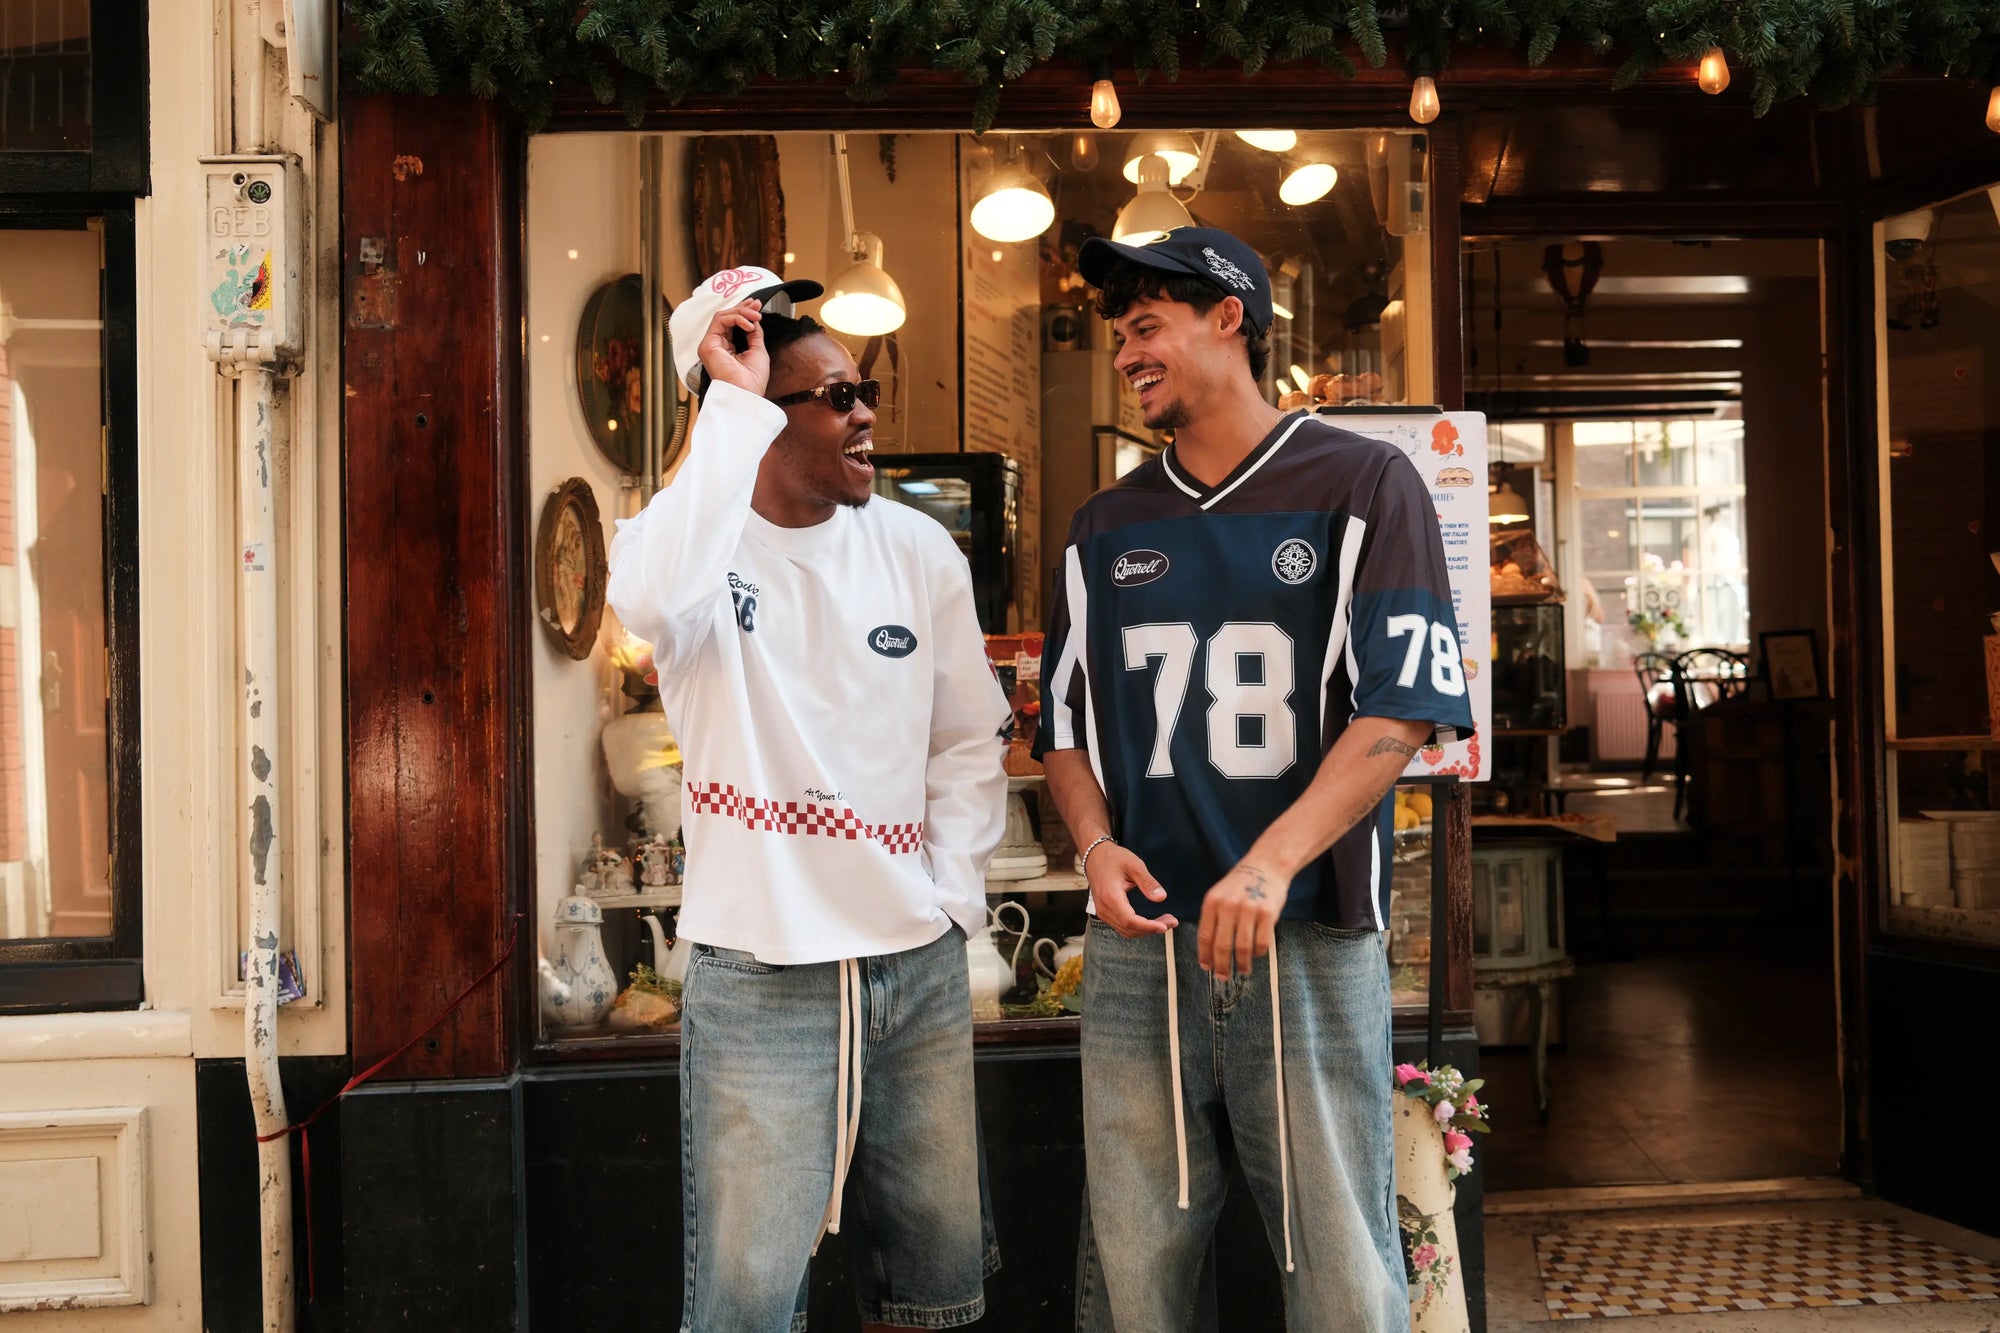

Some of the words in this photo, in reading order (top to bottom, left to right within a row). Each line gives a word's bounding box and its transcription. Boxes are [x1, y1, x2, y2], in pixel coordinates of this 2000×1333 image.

[212, 206, 270, 237] GEB
[1115, 558, 1160, 580] Quotrell
[1387, 613, 1466, 697] 78
[1121, 622, 1296, 779] 78
[815, 790, 836, 802] Your
